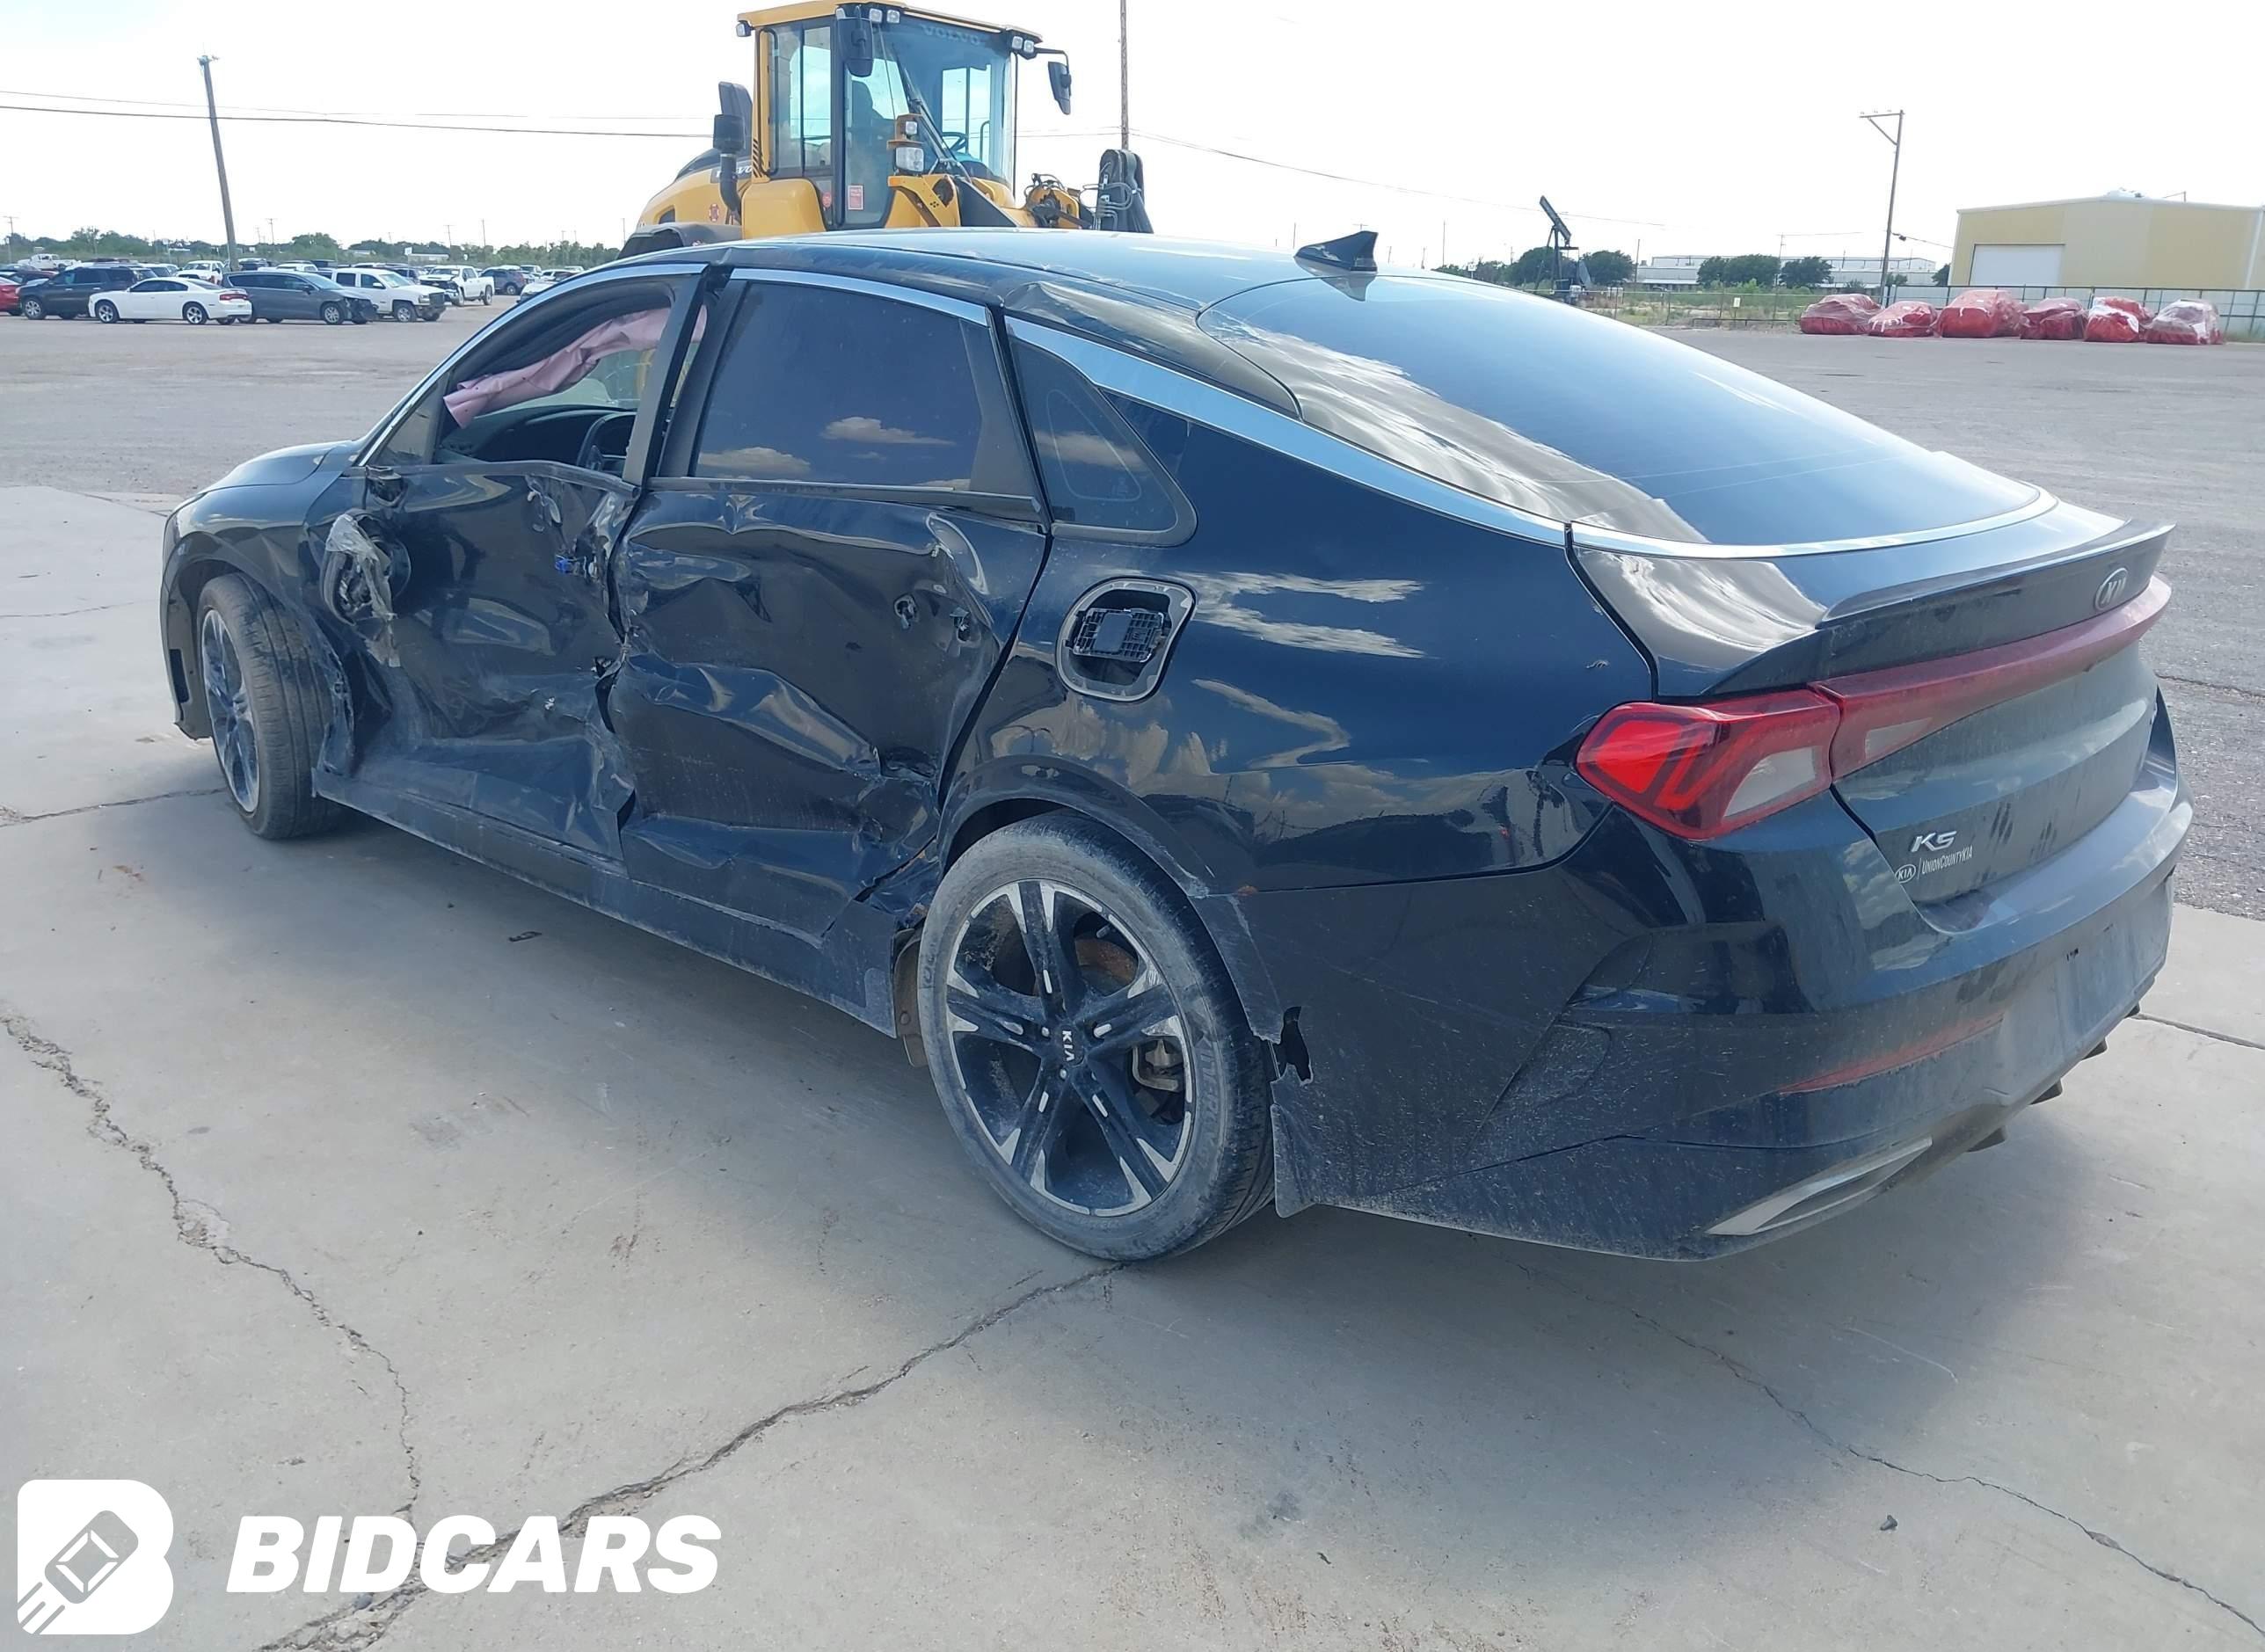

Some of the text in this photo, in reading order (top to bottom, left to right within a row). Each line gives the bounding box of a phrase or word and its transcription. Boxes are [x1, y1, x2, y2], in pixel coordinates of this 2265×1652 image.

[920, 23, 980, 45] VOLVO
[1911, 830, 1957, 853] K5
[1897, 866, 1914, 882] KIA
[1062, 1030, 1074, 1062] KIA
